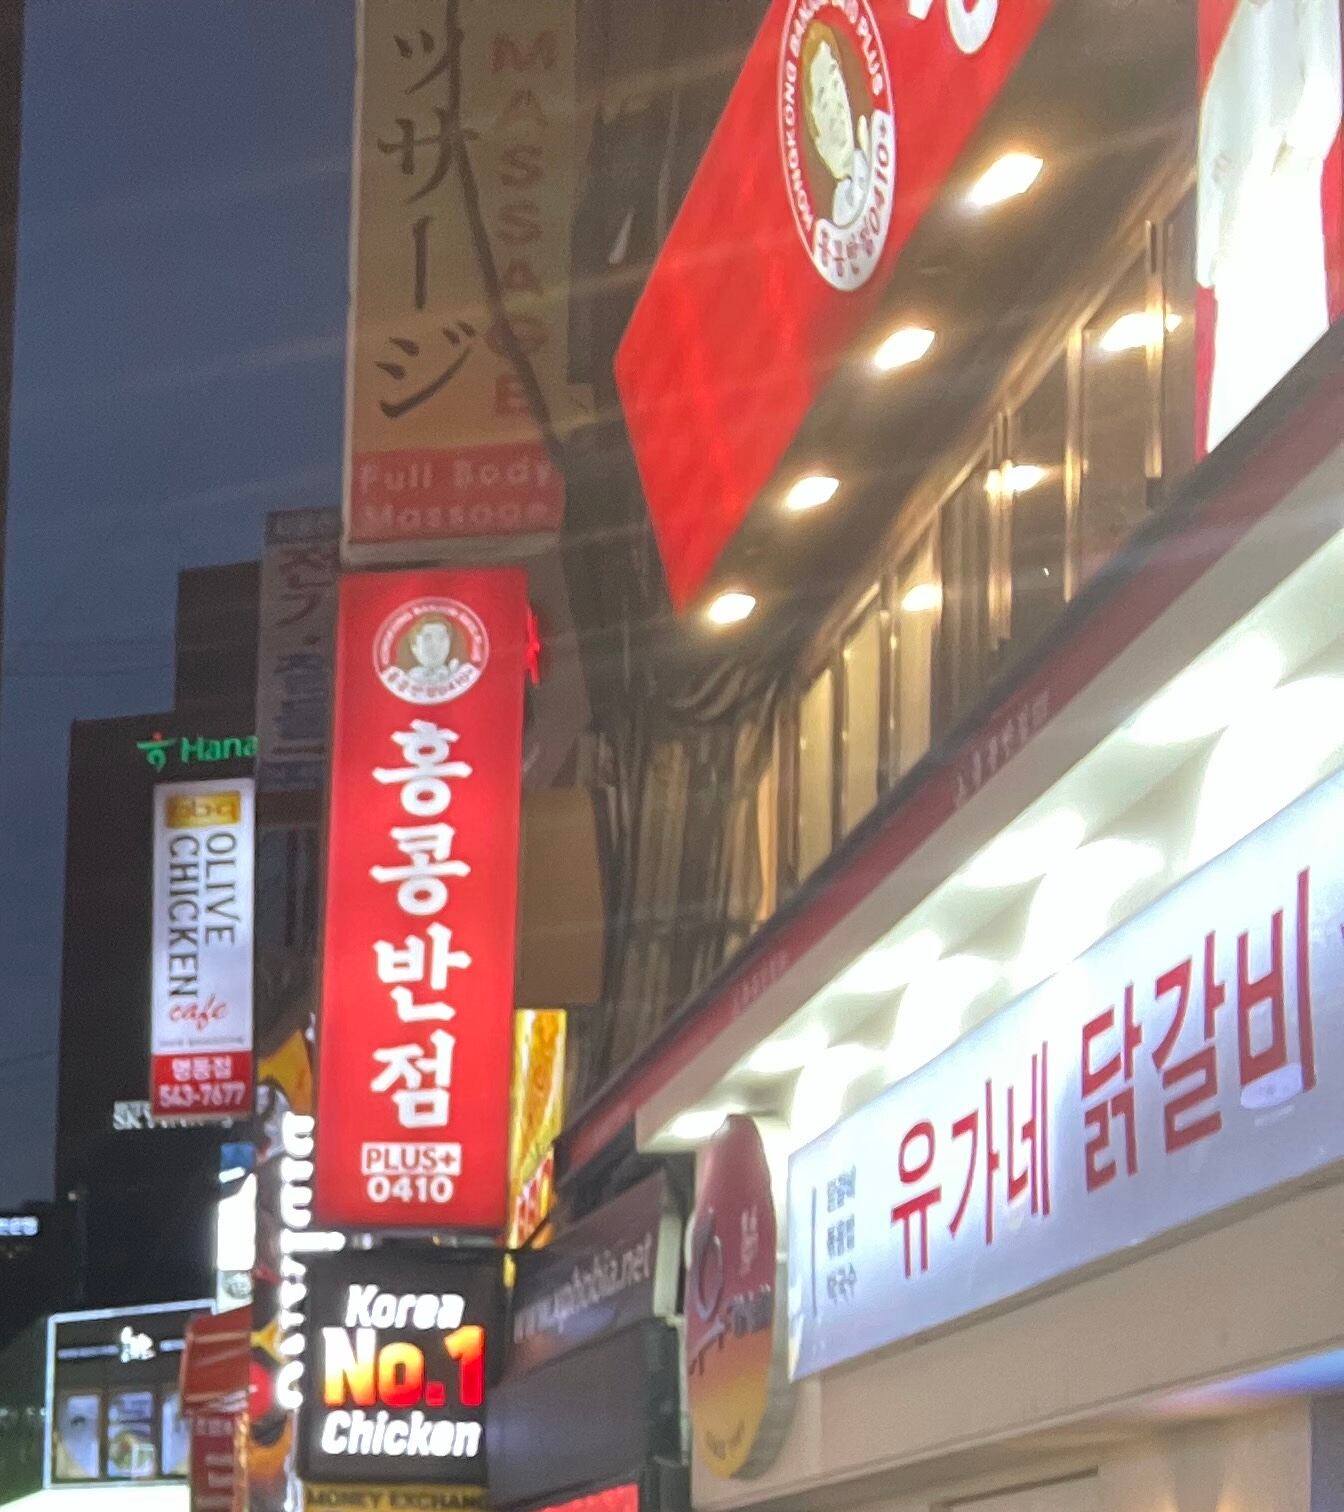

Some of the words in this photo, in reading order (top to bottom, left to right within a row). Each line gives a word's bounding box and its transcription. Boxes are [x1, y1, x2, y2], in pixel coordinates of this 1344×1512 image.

[180, 735, 259, 765] Hana
[168, 835, 200, 998] CHICKEN
[205, 832, 241, 945] OLIVE
[370, 718, 472, 1129] 홍콩반점
[891, 1041, 1052, 1279] 유가네
[1081, 866, 1317, 1193] 닭갈비
[367, 1175, 455, 1204] 0410
[344, 1284, 466, 1330] Korea
[321, 1410, 483, 1457] Chicken
